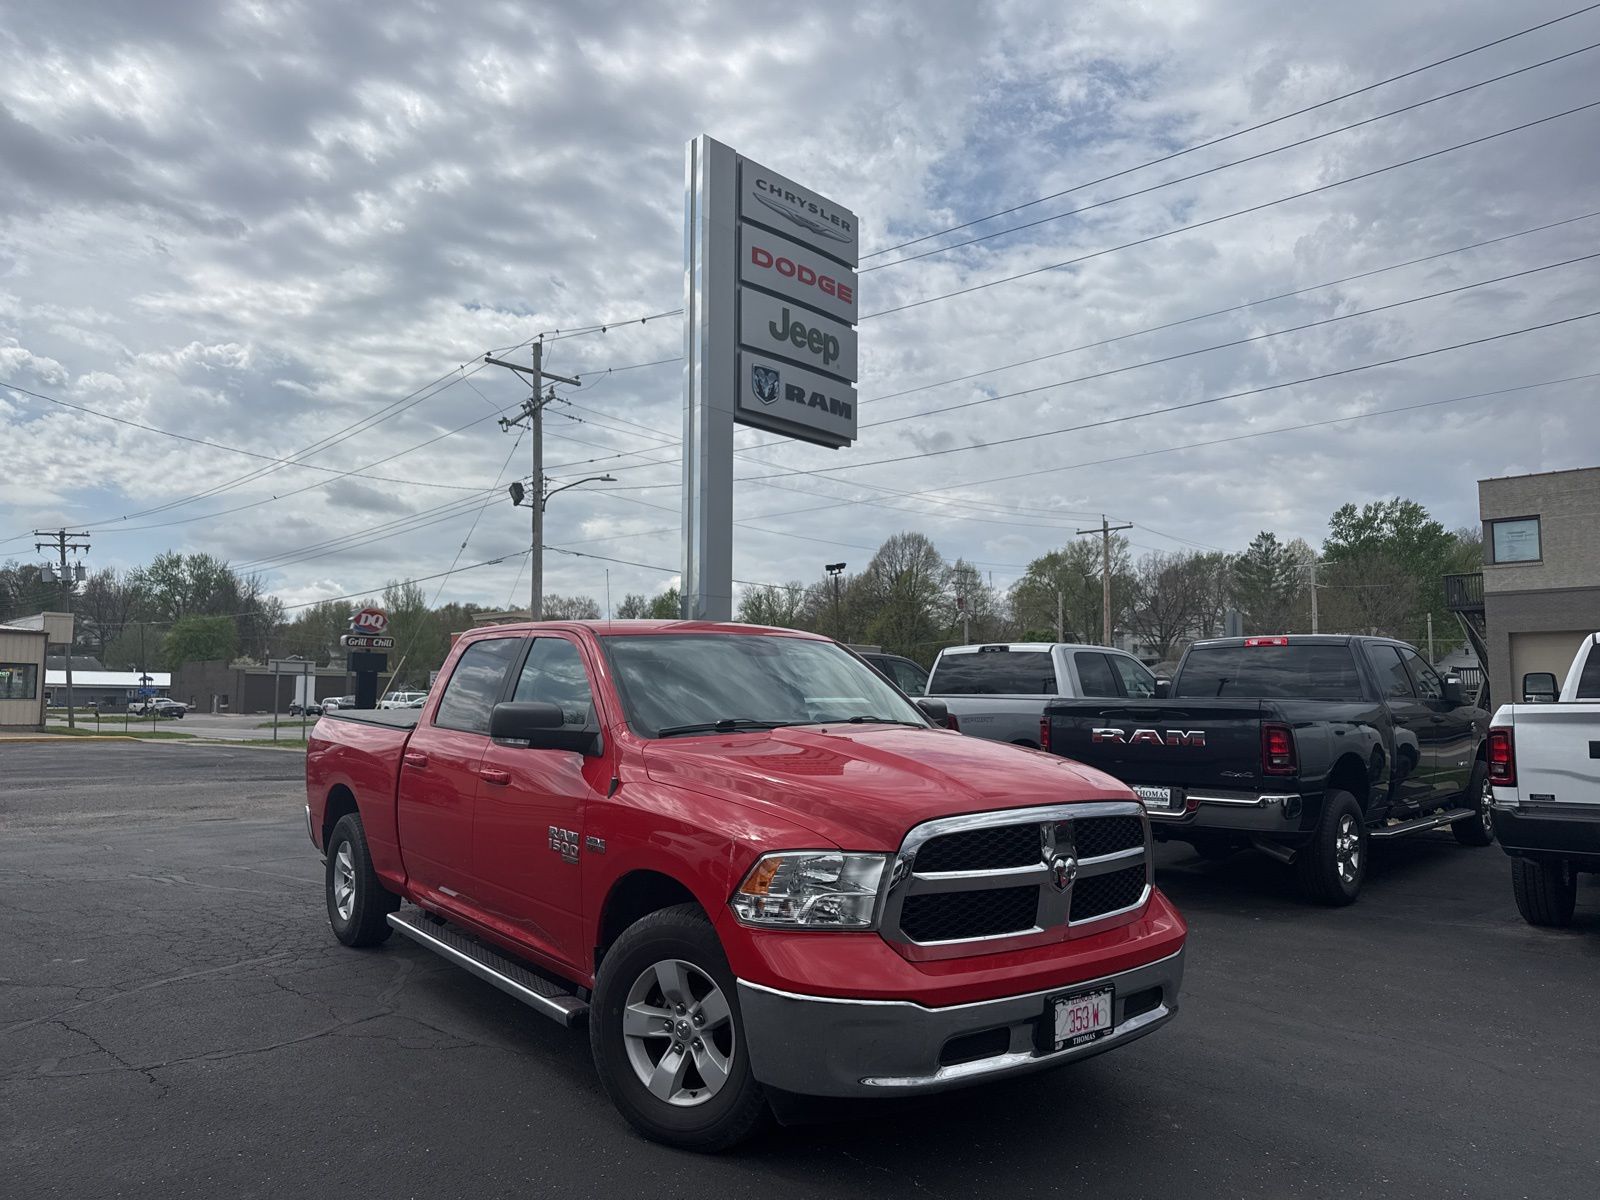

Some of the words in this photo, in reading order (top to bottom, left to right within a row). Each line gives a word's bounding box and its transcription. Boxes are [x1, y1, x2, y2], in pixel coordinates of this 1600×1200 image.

[755, 178, 851, 232] CHRYSLER
[752, 246, 853, 304] DODGE
[769, 307, 840, 365] Jeep
[785, 383, 852, 420] RAM
[359, 613, 384, 629] DQ
[348, 638, 367, 646] Grill
[373, 638, 393, 647] Chill
[1092, 728, 1205, 746] RAM
[548, 825, 579, 844] RAM
[548, 838, 579, 856] 1500
[1069, 1006, 1089, 1033] 353
[1072, 1033, 1096, 1045] THOMAS
